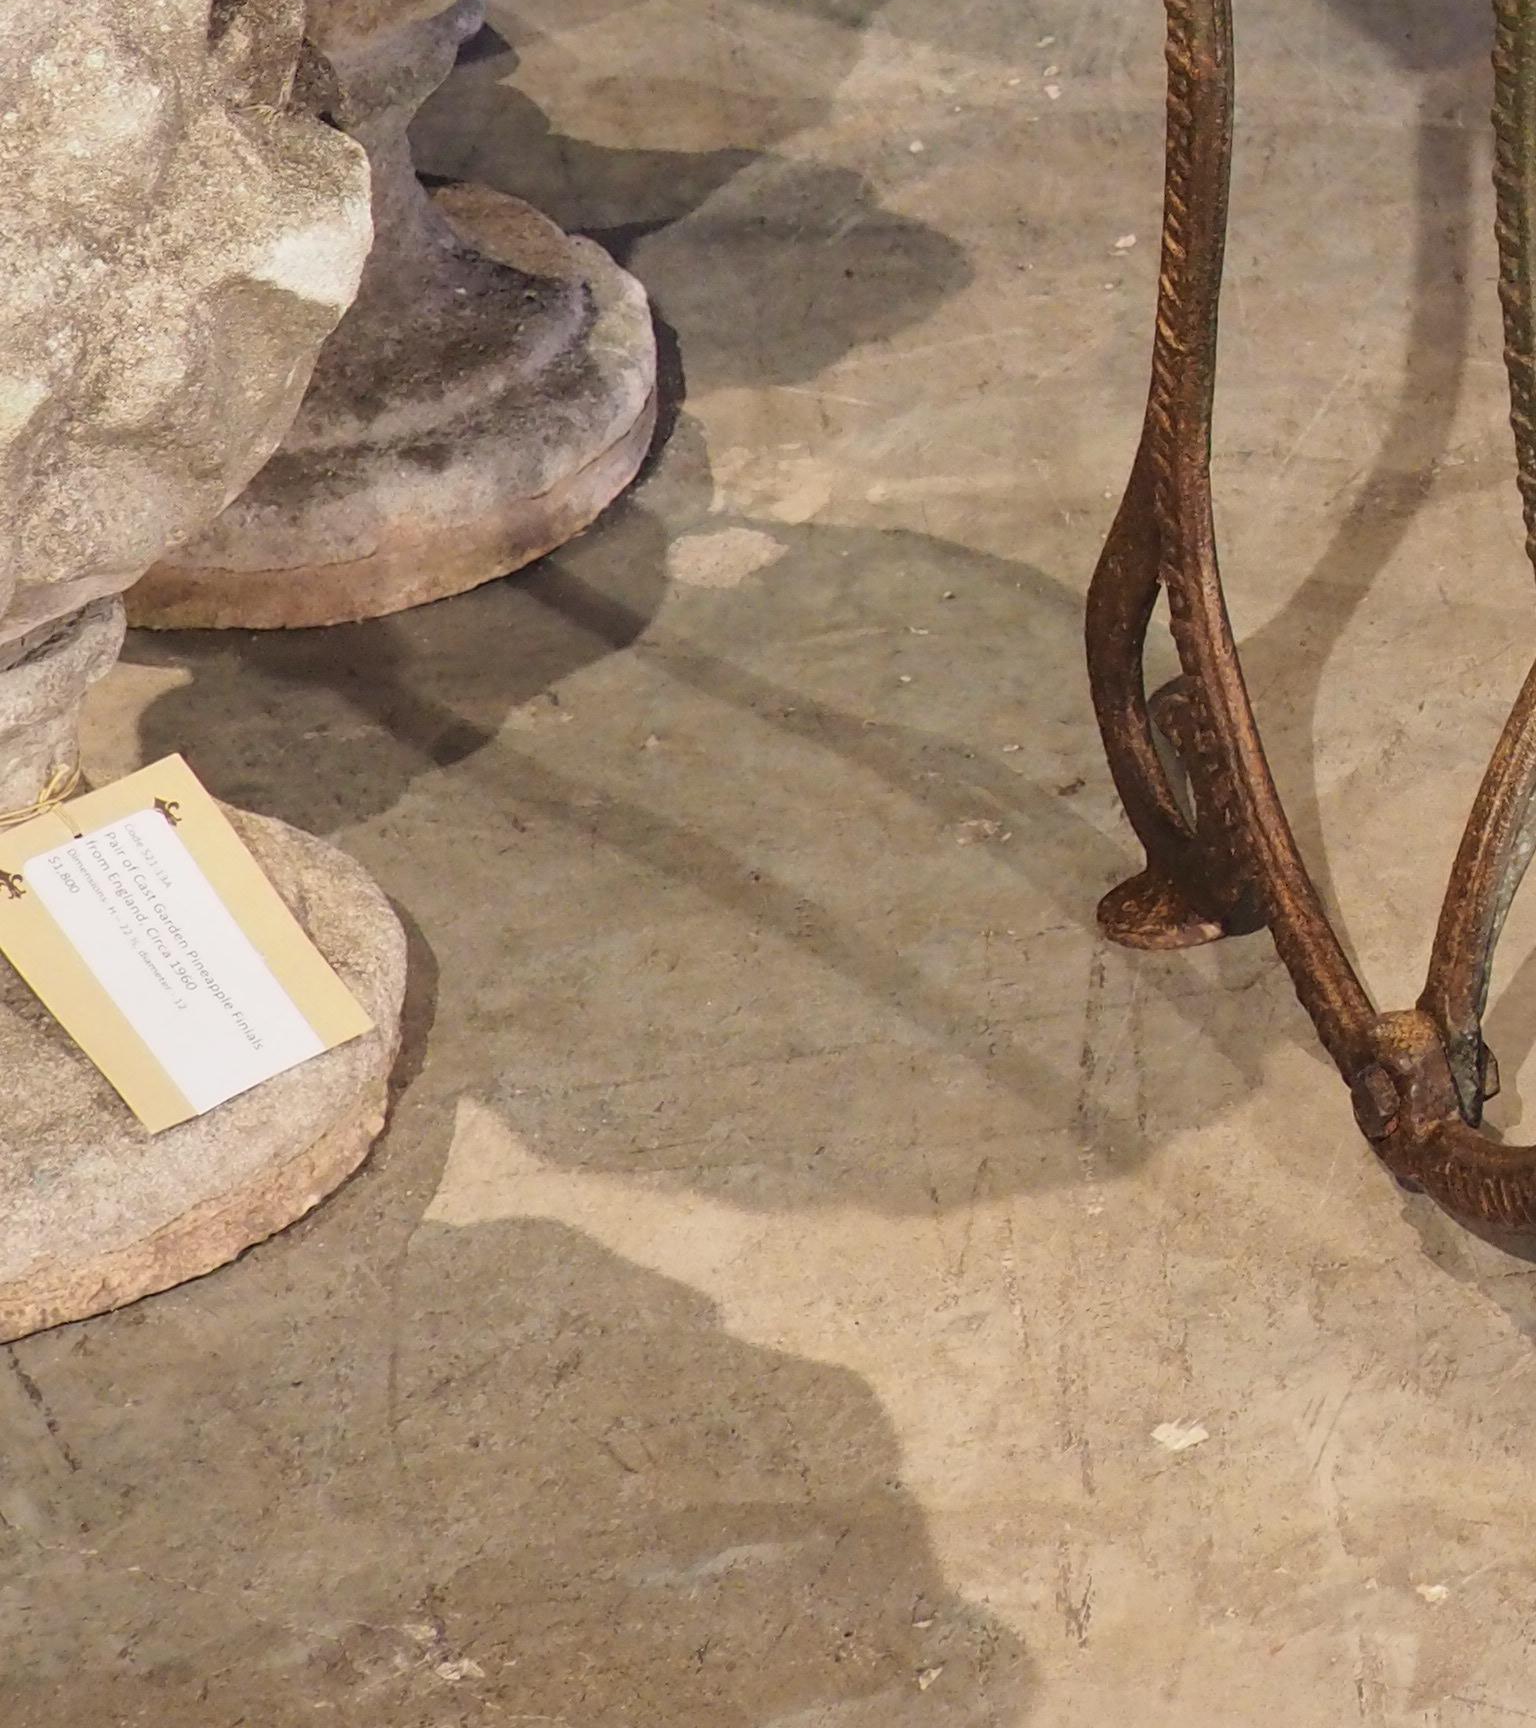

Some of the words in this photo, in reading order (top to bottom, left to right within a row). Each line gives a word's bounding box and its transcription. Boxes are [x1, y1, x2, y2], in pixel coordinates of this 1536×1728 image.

[47, 855, 80, 893] $1,800
[124, 823, 143, 847] Code
[85, 839, 109, 871] from
[107, 872, 148, 925] England,
[146, 927, 171, 958] Circa
[168, 960, 197, 990] 1960
[103, 831, 125, 855] Pair
[121, 859, 139, 872] of
[133, 874, 156, 901] Cast
[153, 903, 188, 948] Garden
[186, 950, 233, 1009] Pineapple
[231, 1010, 263, 1050] Finials
